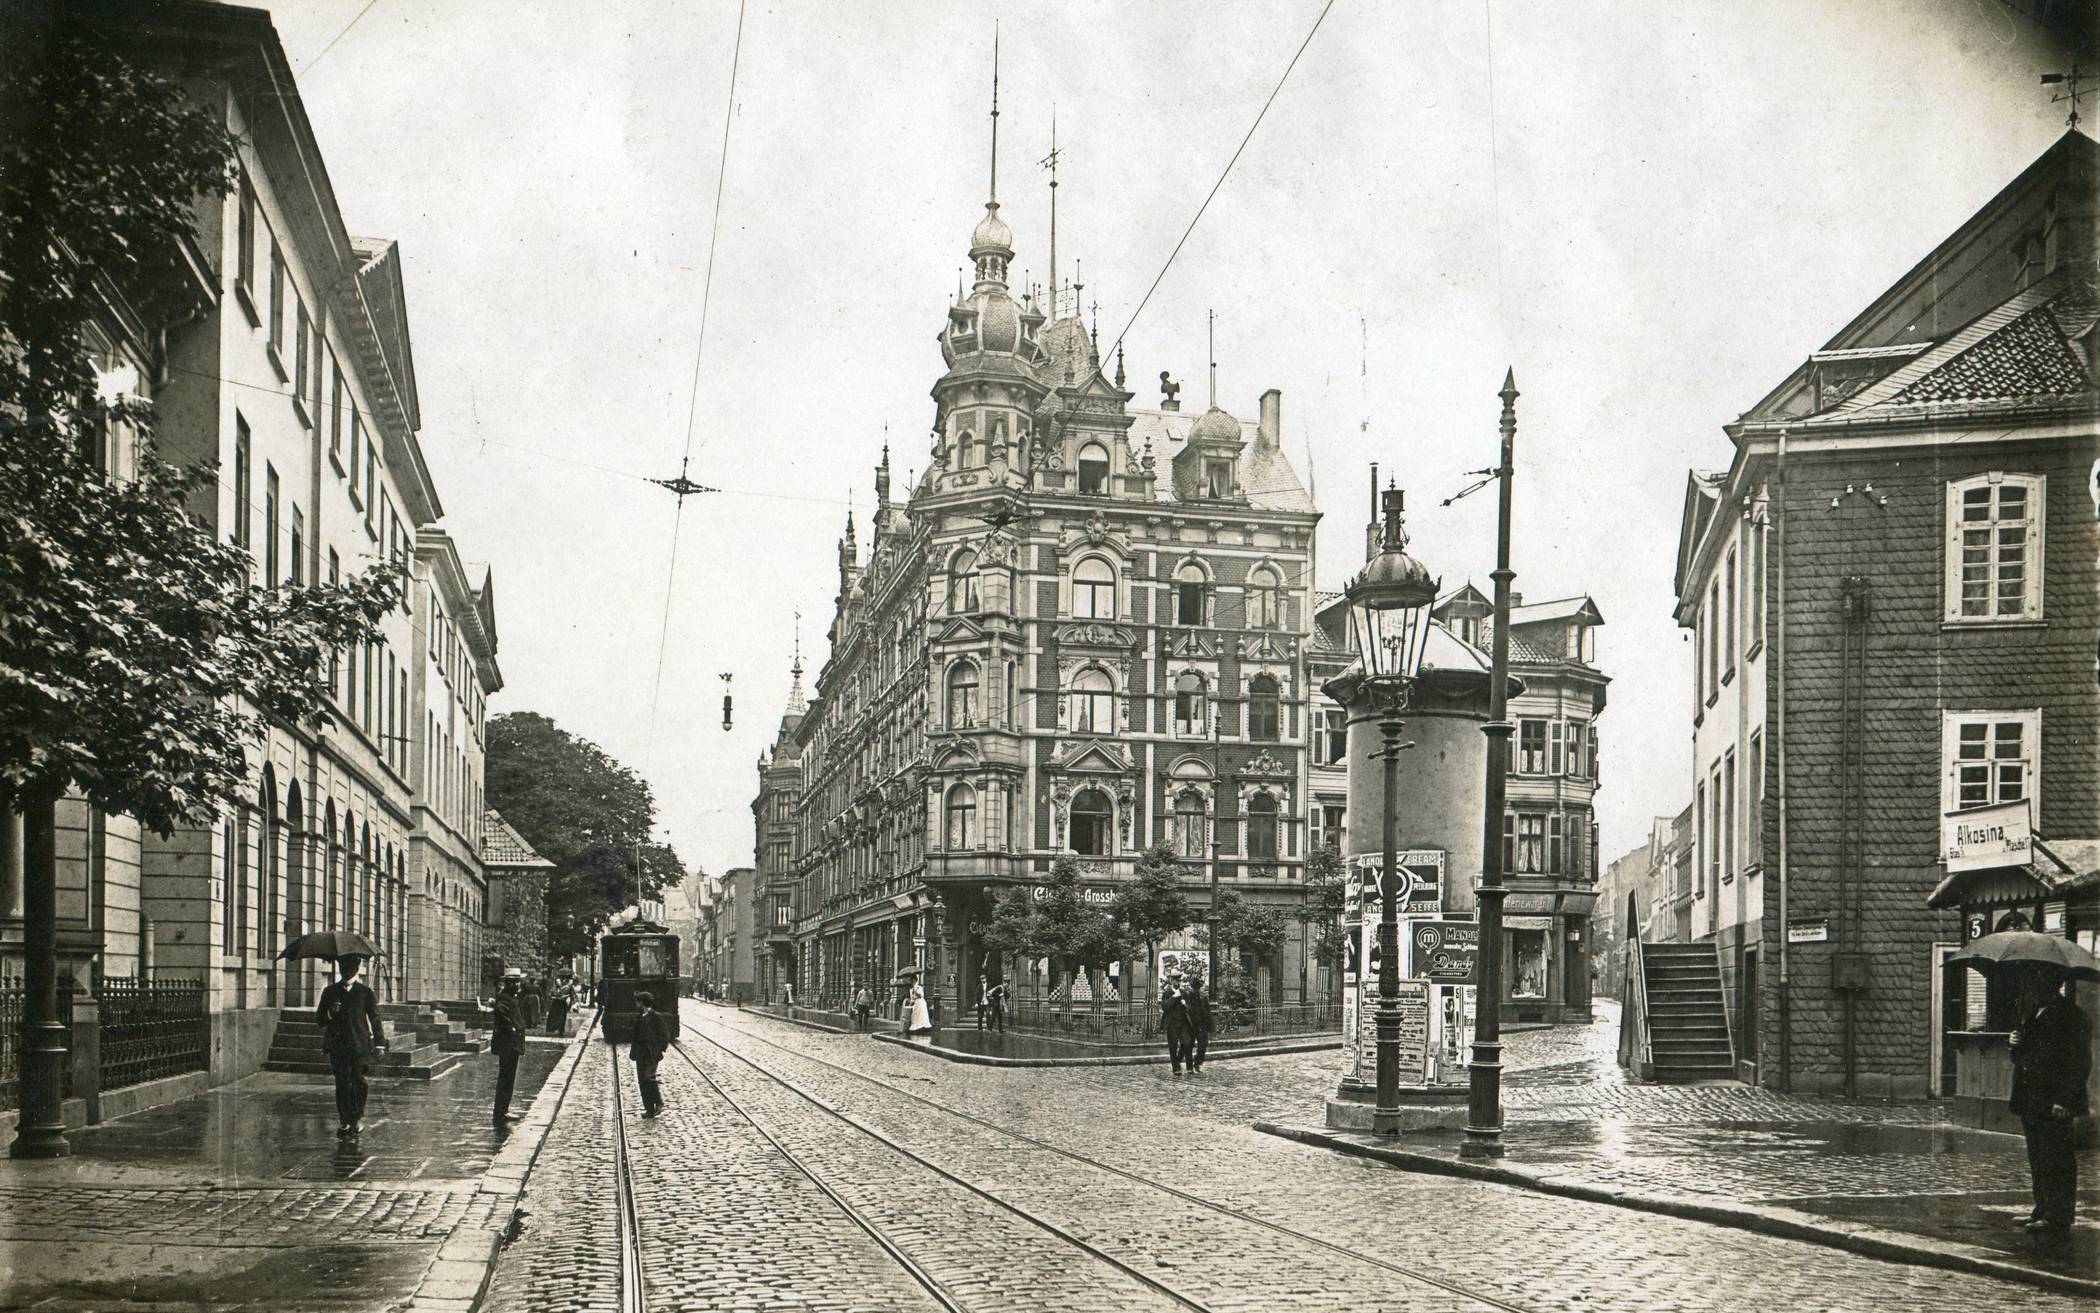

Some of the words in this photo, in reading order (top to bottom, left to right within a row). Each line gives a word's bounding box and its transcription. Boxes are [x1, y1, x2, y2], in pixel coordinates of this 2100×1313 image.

[1957, 824, 2004, 846] Alkosina
[1407, 855, 1436, 865] CREAM
[1411, 903, 1438, 912] SEIFE
[1971, 920, 1981, 938] 5
